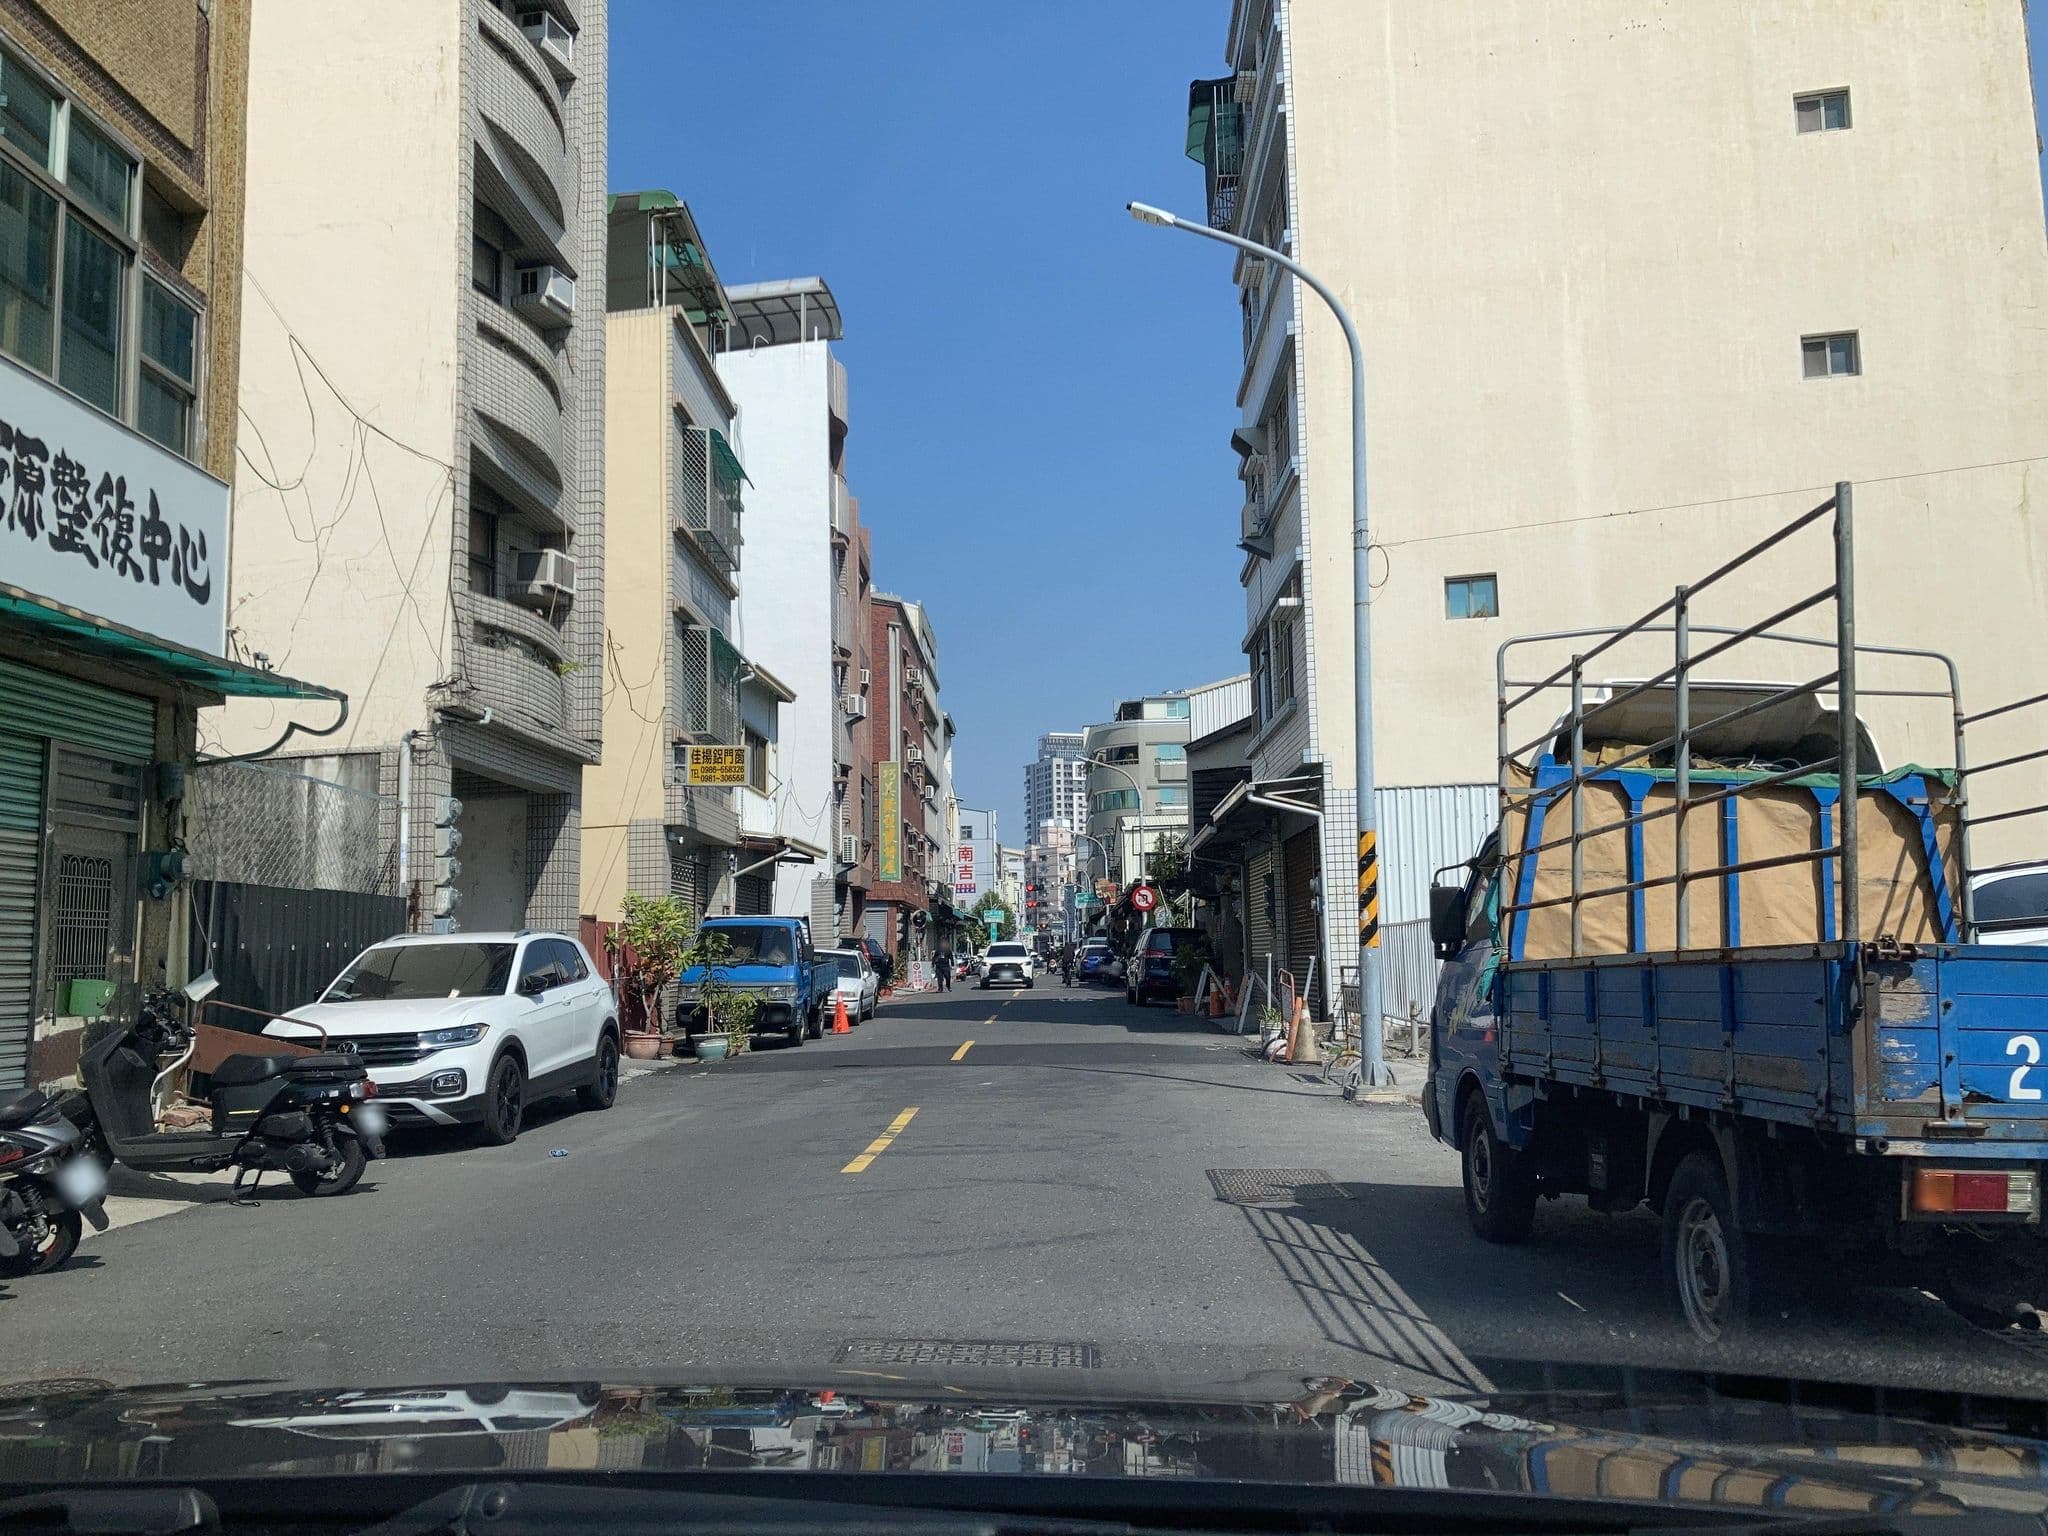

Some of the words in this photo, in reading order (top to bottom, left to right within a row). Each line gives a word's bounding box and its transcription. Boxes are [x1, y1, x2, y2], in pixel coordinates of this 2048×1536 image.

[691, 769, 700, 779] TEL
[957, 846, 974, 880] 南吉
[2006, 1035, 2042, 1100] 2
